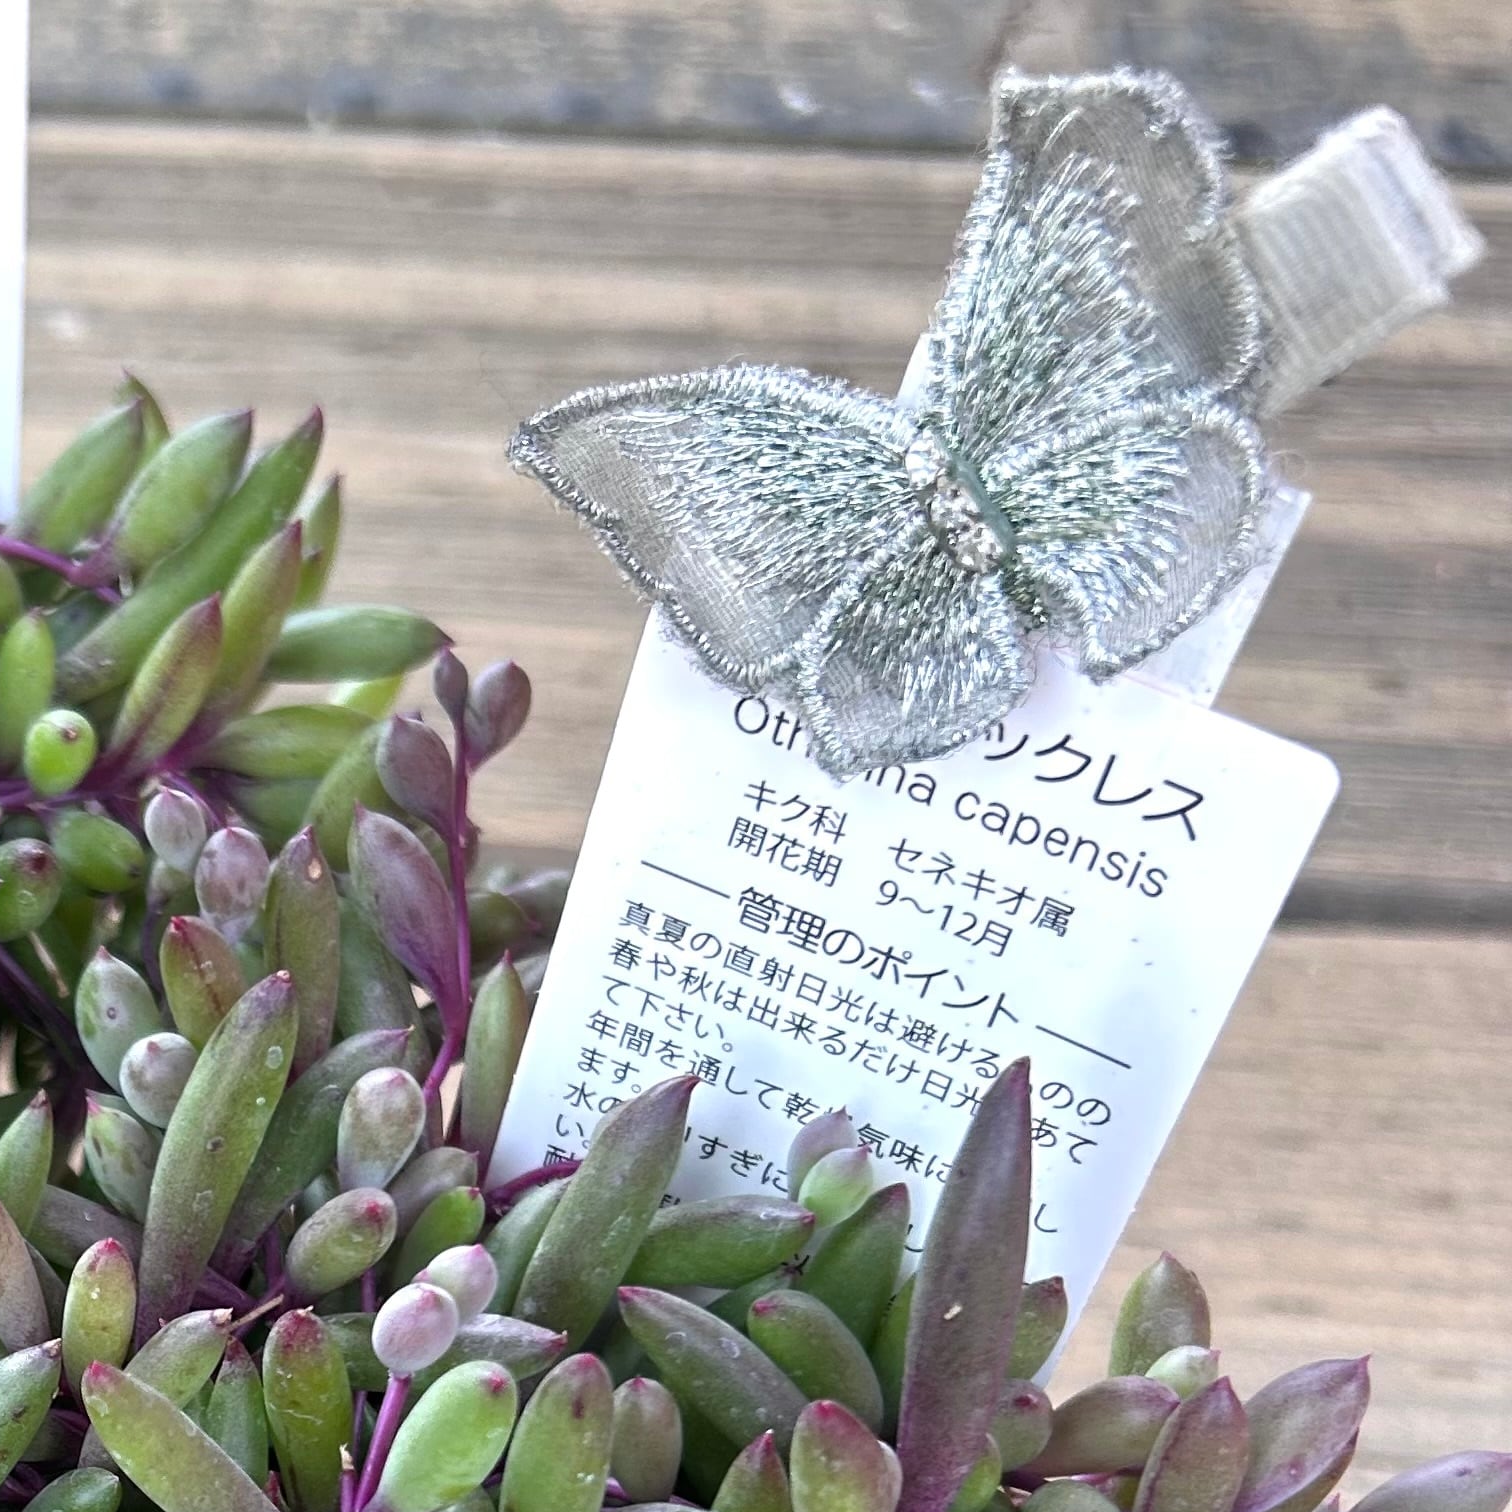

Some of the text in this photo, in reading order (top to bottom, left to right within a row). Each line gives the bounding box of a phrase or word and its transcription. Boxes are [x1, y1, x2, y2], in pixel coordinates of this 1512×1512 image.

[727, 815, 844, 888] 開花期
[743, 779, 1076, 938] キク科 セネキオ属
[955, 790, 1169, 898] capensis
[600, 974, 735, 1056] て下さい。
[618, 898, 1112, 1127] 真夏の直射日光は避けるのの
[737, 885, 1020, 1030] 管理のポイント
[607, 937, 1100, 1166] 春や秋は出来るだけ日光あて
